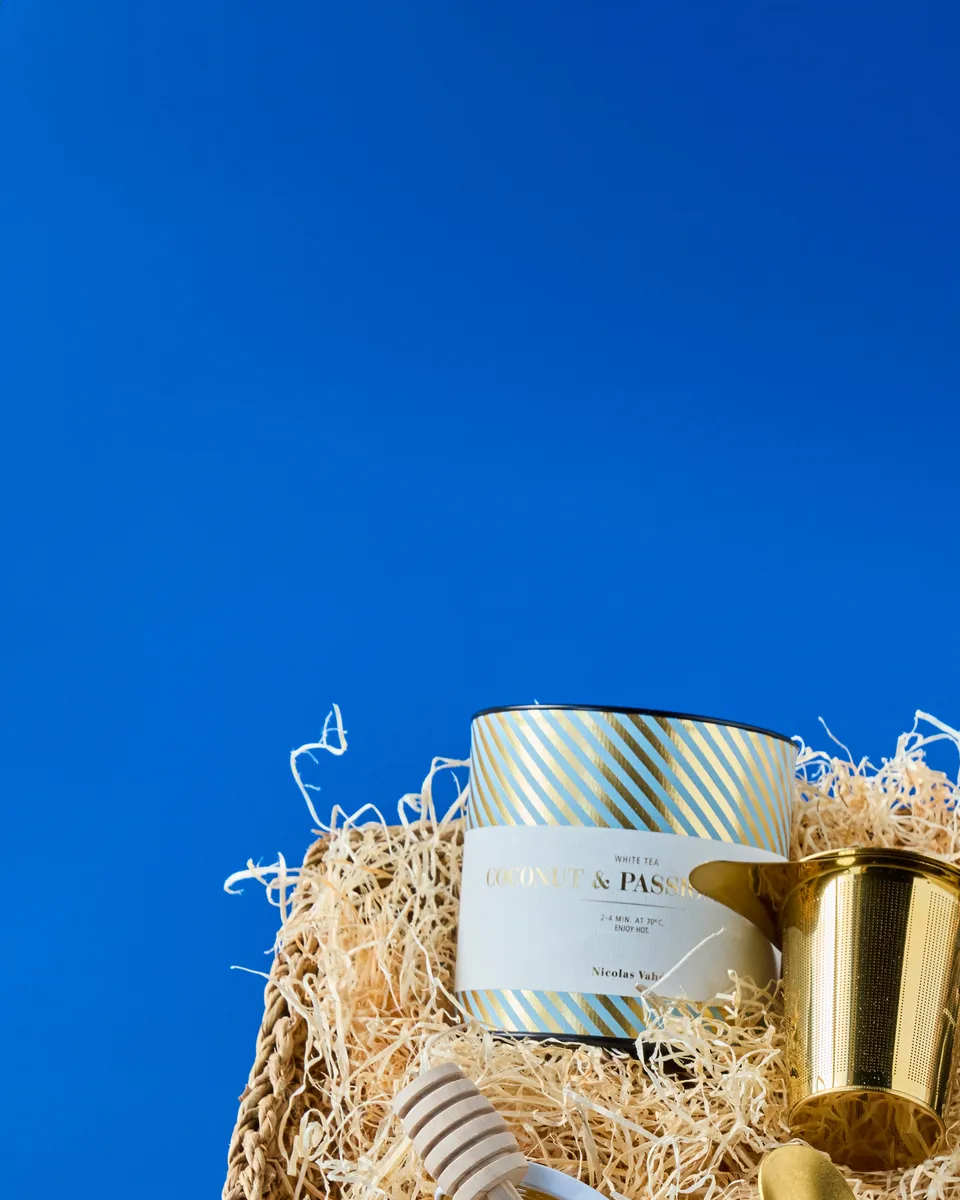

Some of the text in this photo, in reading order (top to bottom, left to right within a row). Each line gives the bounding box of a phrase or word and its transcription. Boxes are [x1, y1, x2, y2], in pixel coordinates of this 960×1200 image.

[614, 855, 659, 866] WHITE TEA
[486, 866, 708, 900] COCONUT & PASSI
[616, 916, 632, 924] MIN.
[614, 924, 650, 934] ENJOY HOT.
[592, 966, 634, 979] Nicolas
